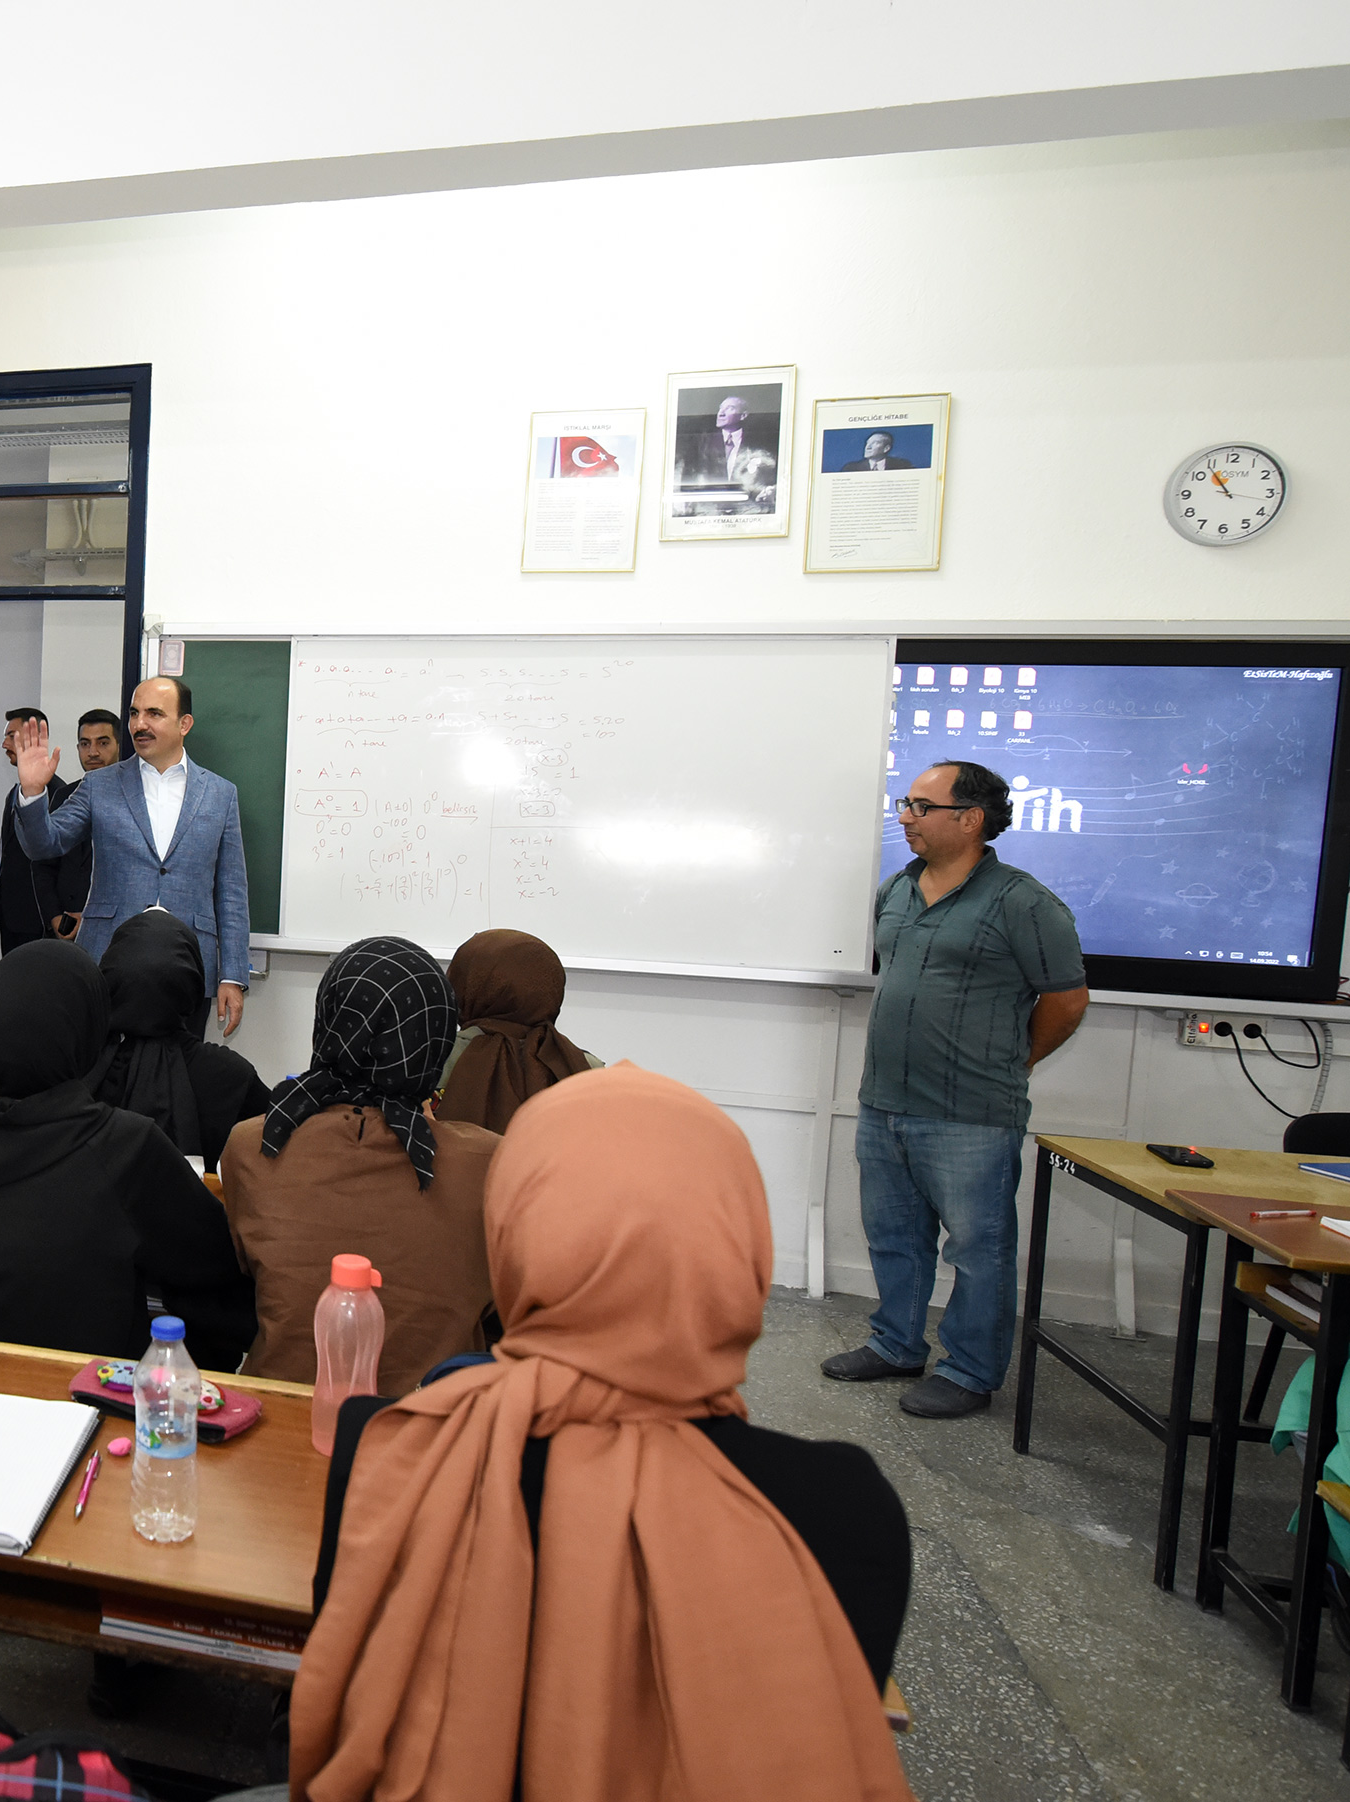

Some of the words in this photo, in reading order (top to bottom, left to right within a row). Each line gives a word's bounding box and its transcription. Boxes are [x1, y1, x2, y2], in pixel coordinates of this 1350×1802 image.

[1207, 459, 1216, 469] 11
[1225, 453, 1241, 464] 12
[1251, 458, 1256, 468] 1
[1191, 471, 1207, 481] 10
[1260, 470, 1271, 480] 2
[1181, 489, 1192, 500] 9
[1265, 488, 1275, 499] 3
[1184, 507, 1196, 518] 8
[1256, 506, 1266, 517] 4
[1197, 519, 1208, 530] 7
[1218, 523, 1228, 534] 6
[1241, 518, 1251, 529] 5
